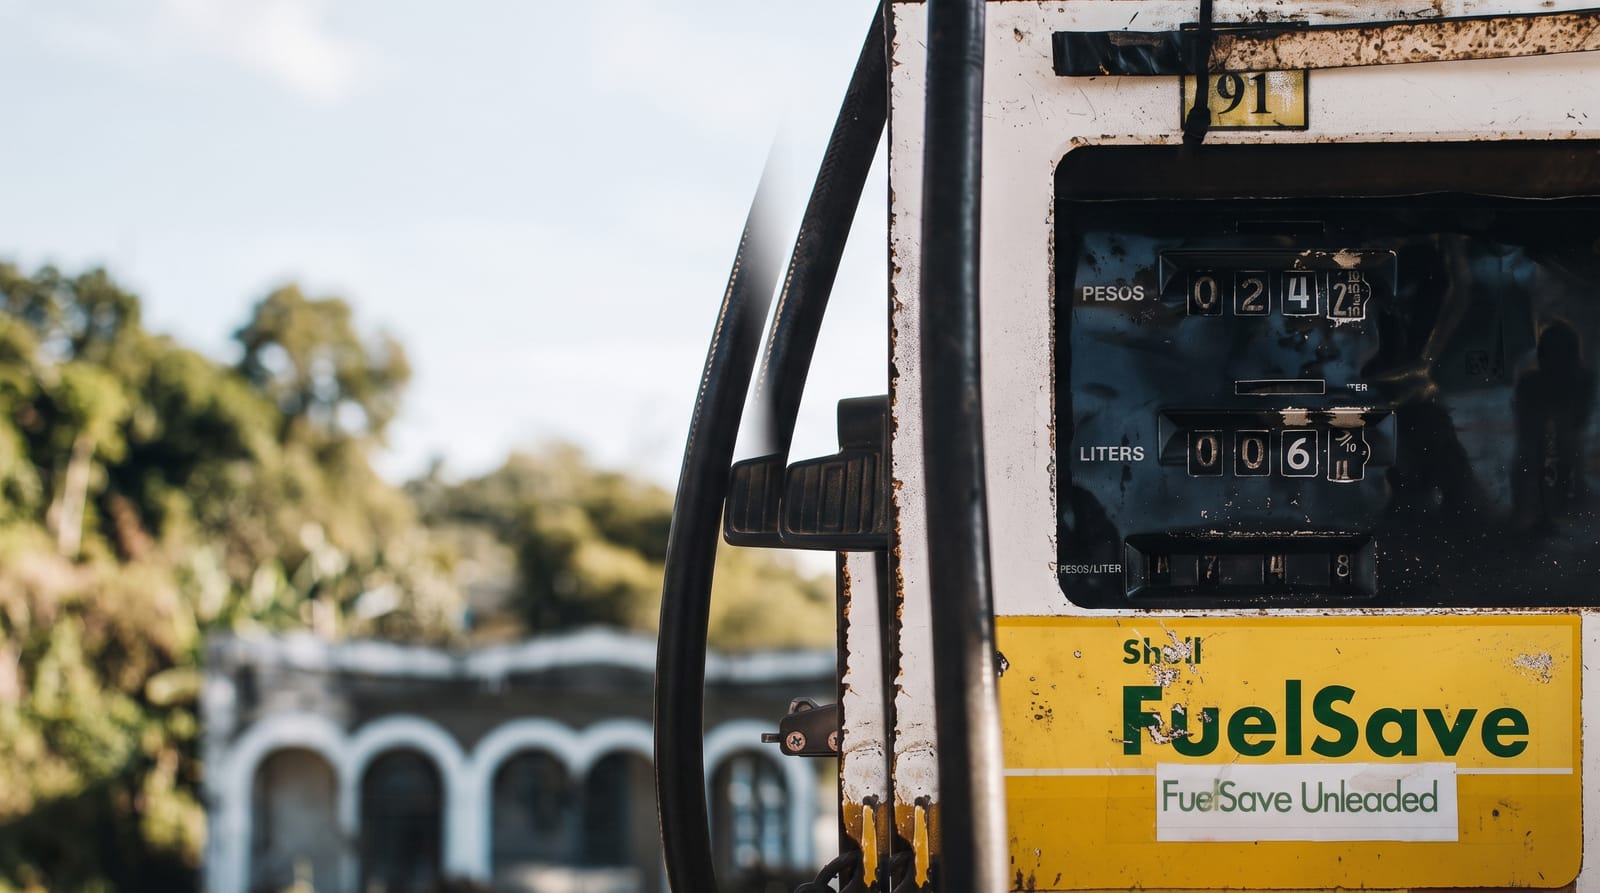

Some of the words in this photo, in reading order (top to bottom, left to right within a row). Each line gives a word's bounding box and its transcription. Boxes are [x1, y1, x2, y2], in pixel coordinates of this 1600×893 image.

[1216, 73, 1272, 115] 91
[1082, 285, 1145, 302] PESOS
[1241, 278, 1264, 311] 2
[1288, 276, 1310, 309] 4
[1080, 446, 1145, 462] LITERS
[1287, 437, 1310, 470] 6
[1060, 564, 1122, 574] PESOS/LITER
[1123, 679, 1530, 758] FuelSave
[1162, 778, 1292, 812] FuelSave
[1301, 779, 1438, 813] Unleaded
